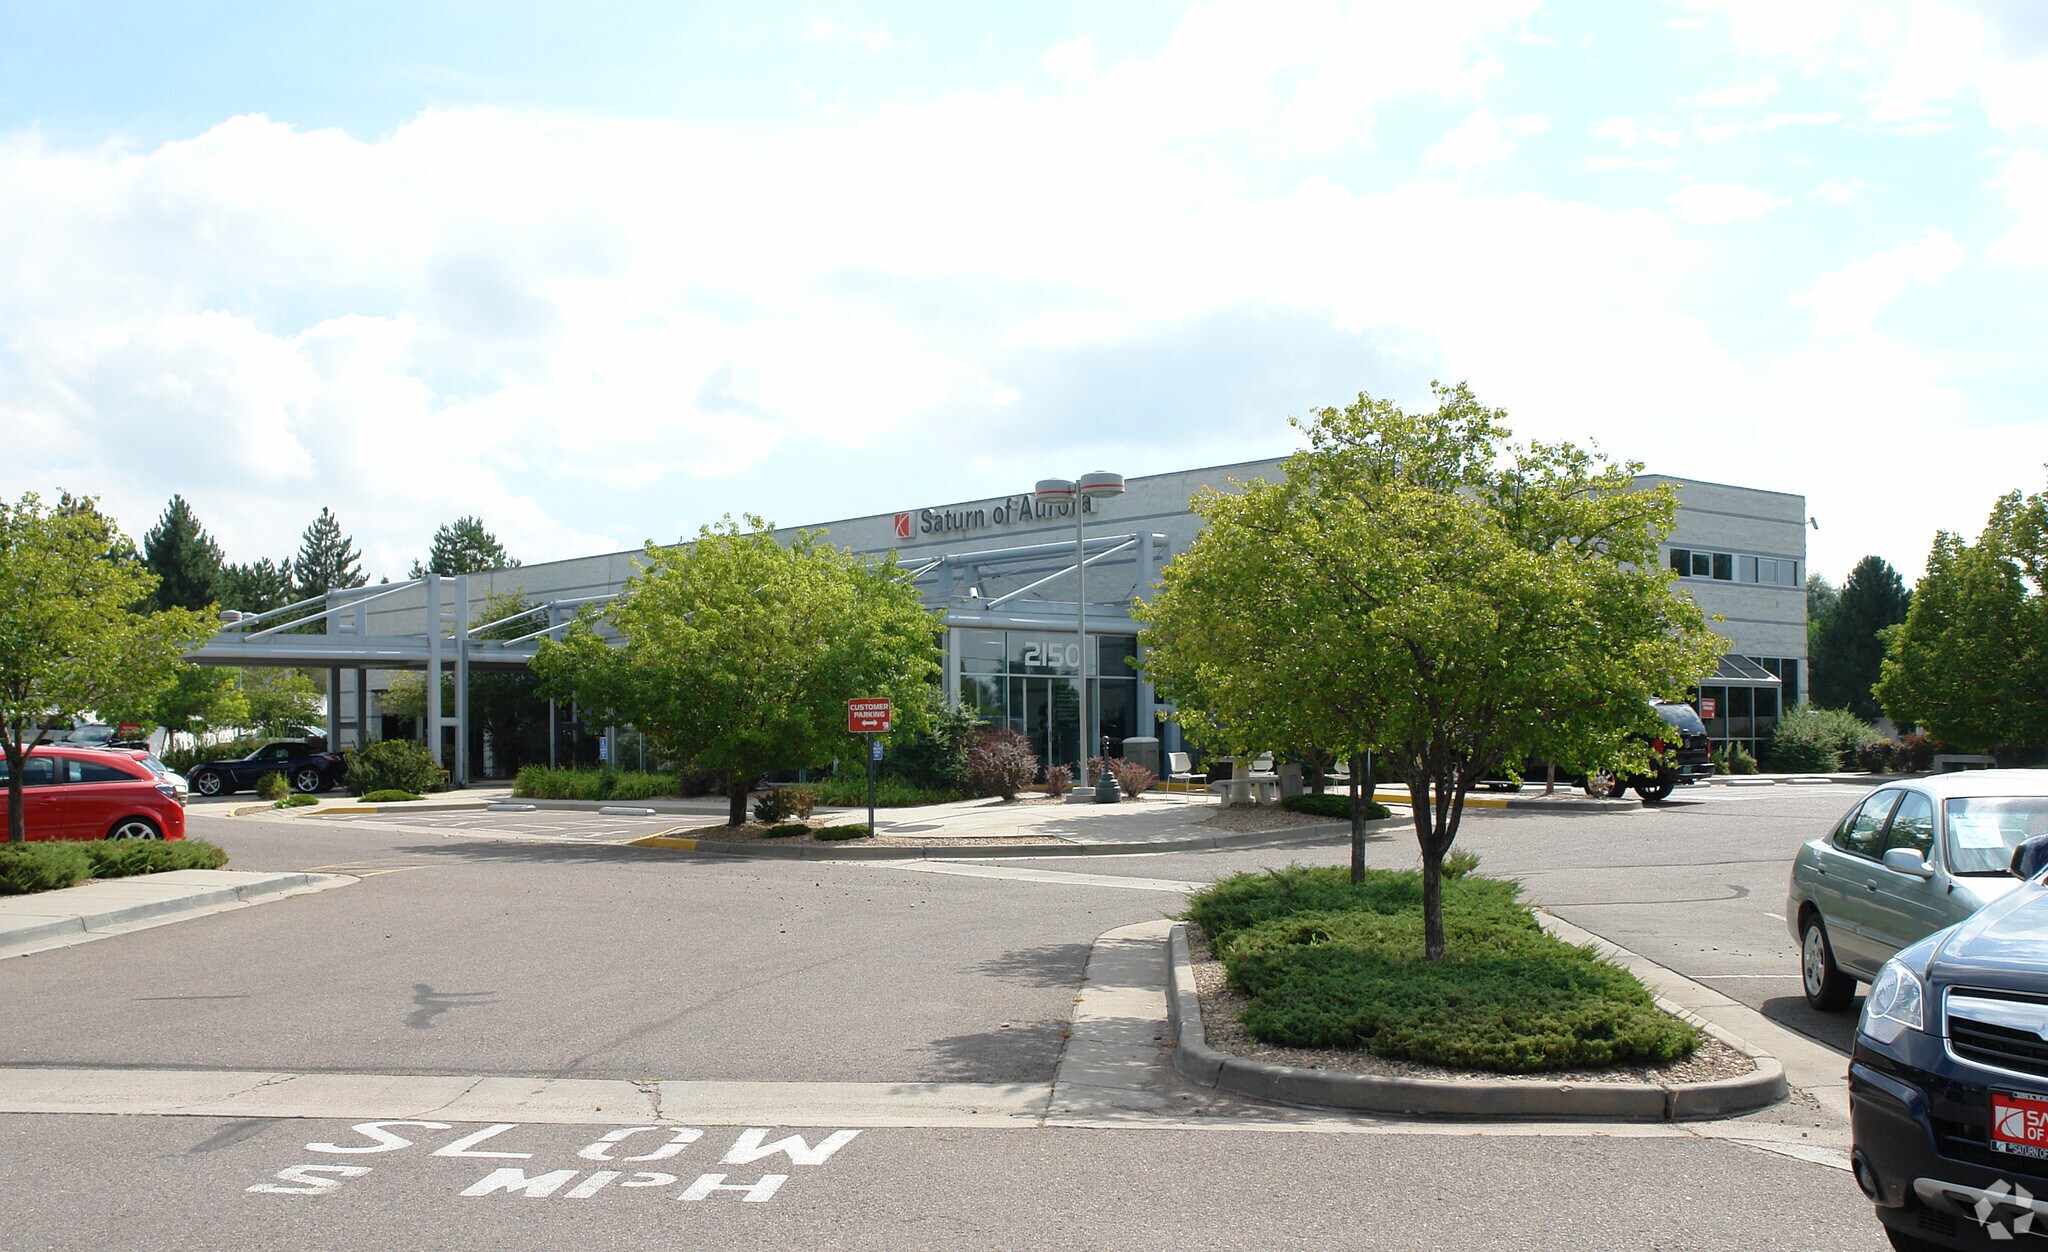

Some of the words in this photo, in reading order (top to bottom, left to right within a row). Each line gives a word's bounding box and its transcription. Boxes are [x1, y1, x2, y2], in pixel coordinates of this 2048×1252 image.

[920, 508, 984, 534] Saturn
[993, 498, 1012, 525] of
[1024, 641, 1079, 668] 2150
[850, 703, 889, 711] CUSTOMER
[304, 1120, 864, 1166] SLOW
[2027, 1127, 2044, 1141] OF
[458, 1167, 790, 1203] MPH
